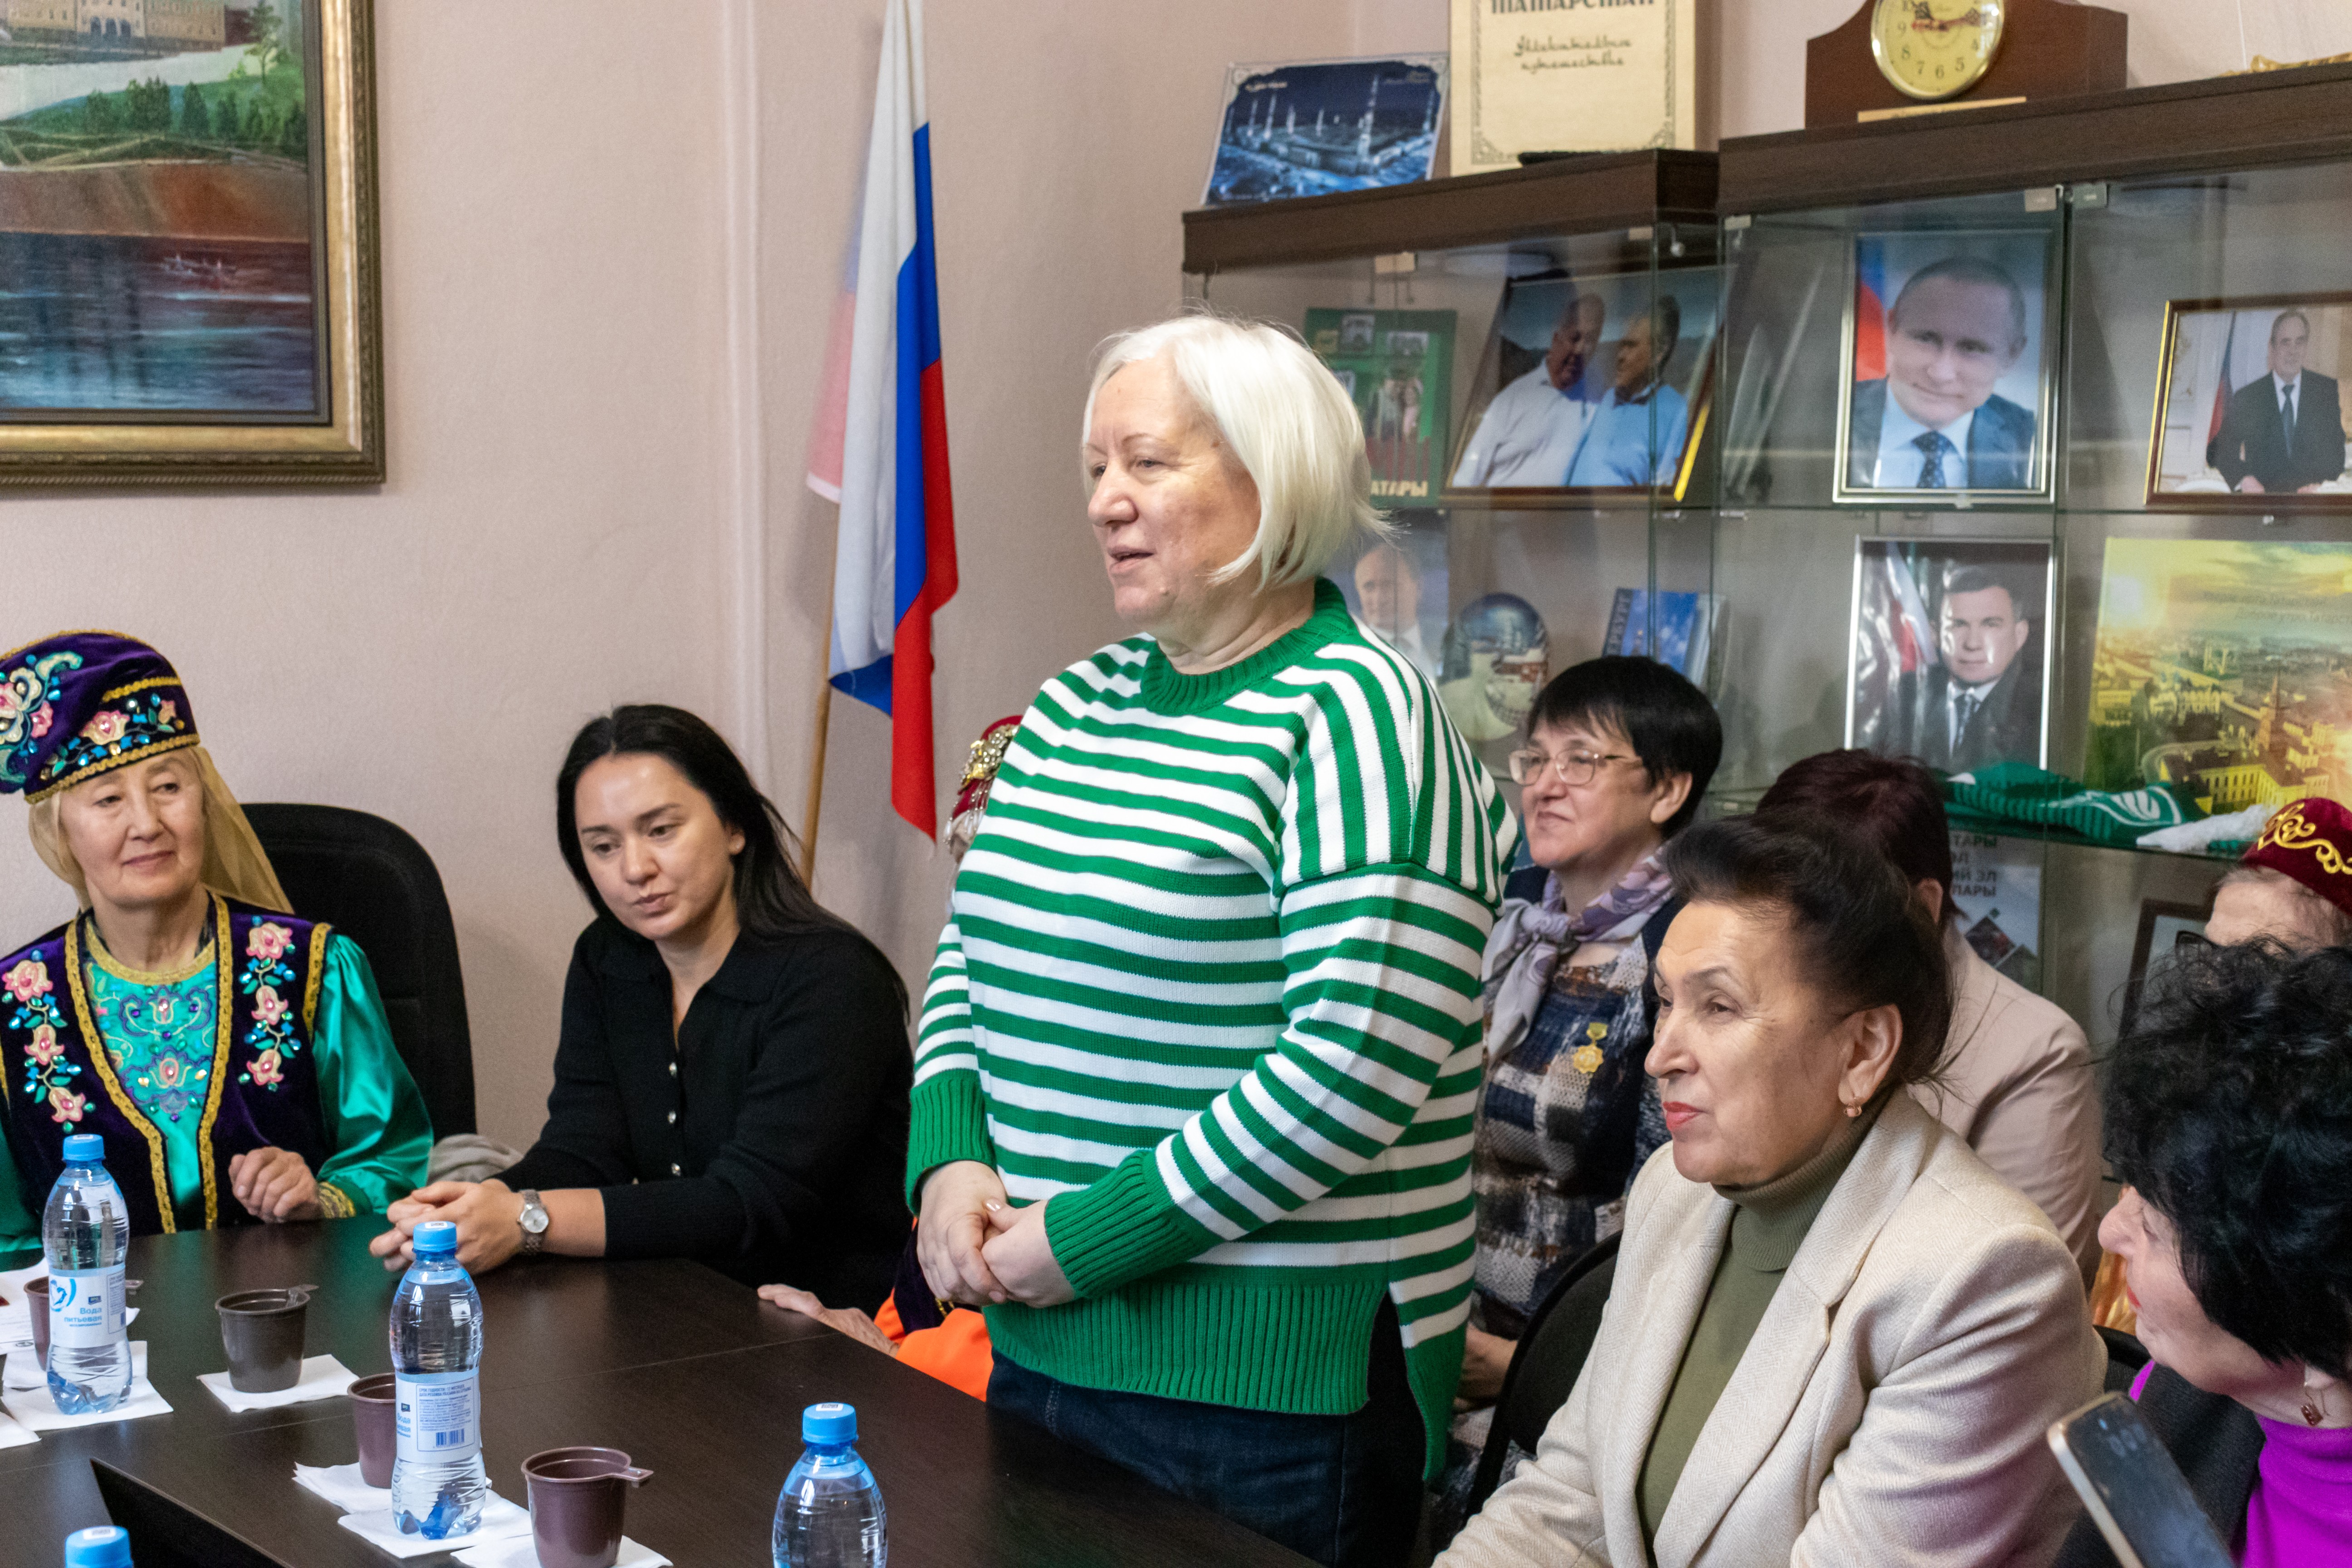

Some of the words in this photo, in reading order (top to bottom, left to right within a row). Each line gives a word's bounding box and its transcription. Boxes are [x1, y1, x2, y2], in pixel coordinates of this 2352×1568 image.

[1901, 44, 1911, 60] 8
[1917, 60, 1925, 75] 7
[1935, 64, 1944, 79] 6
[1955, 56, 1965, 72] 5
[1371, 480, 1428, 497] АТАРЫ
